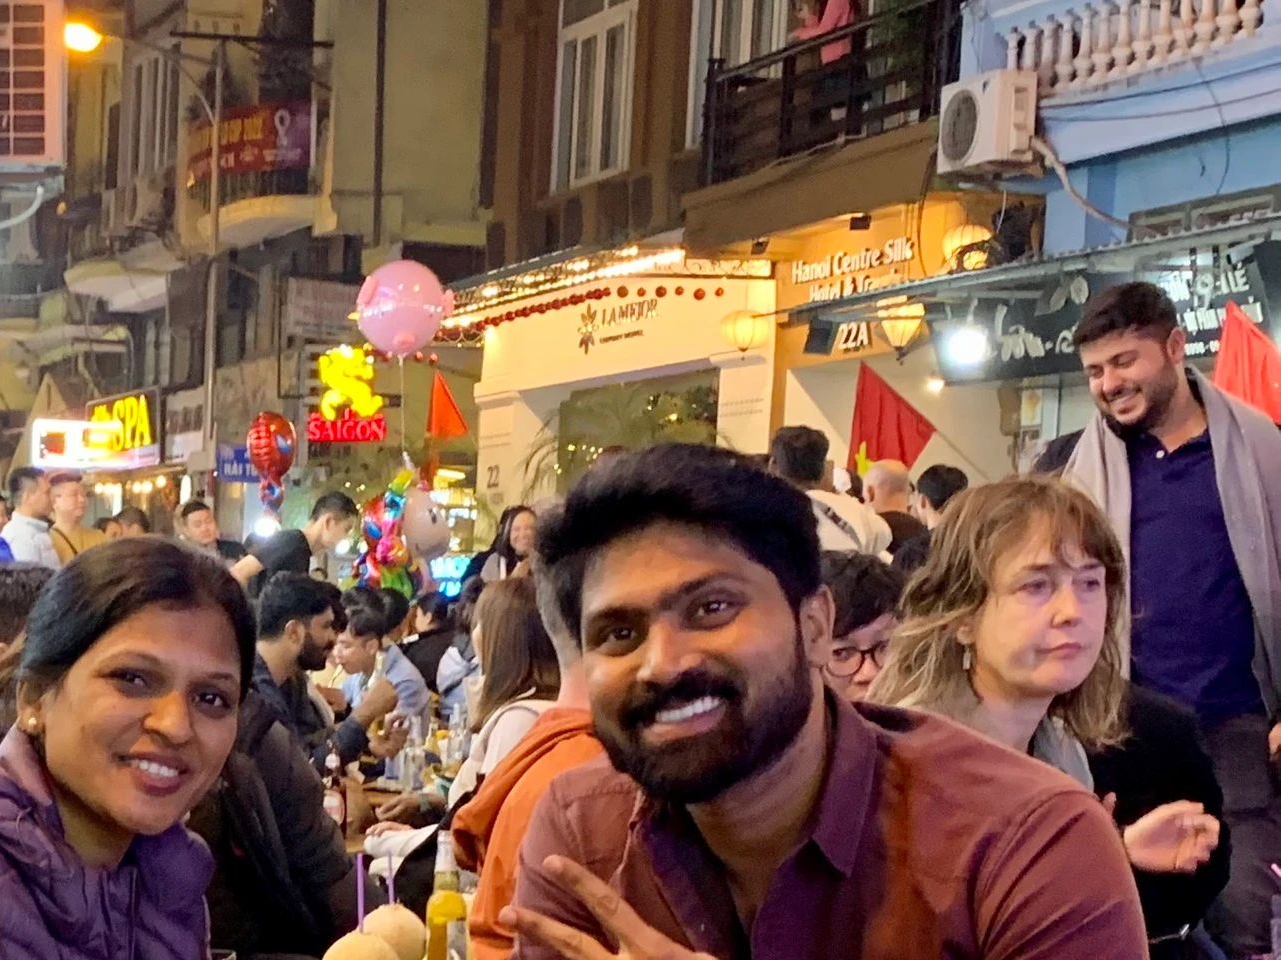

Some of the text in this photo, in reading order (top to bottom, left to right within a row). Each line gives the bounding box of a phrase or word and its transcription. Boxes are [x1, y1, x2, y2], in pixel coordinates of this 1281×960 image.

[792, 236, 915, 284] Hanoi Centre Silk
[838, 321, 869, 350] 22A
[112, 393, 152, 452] SPA
[309, 420, 386, 441] SAIGON
[486, 464, 500, 488] 22
